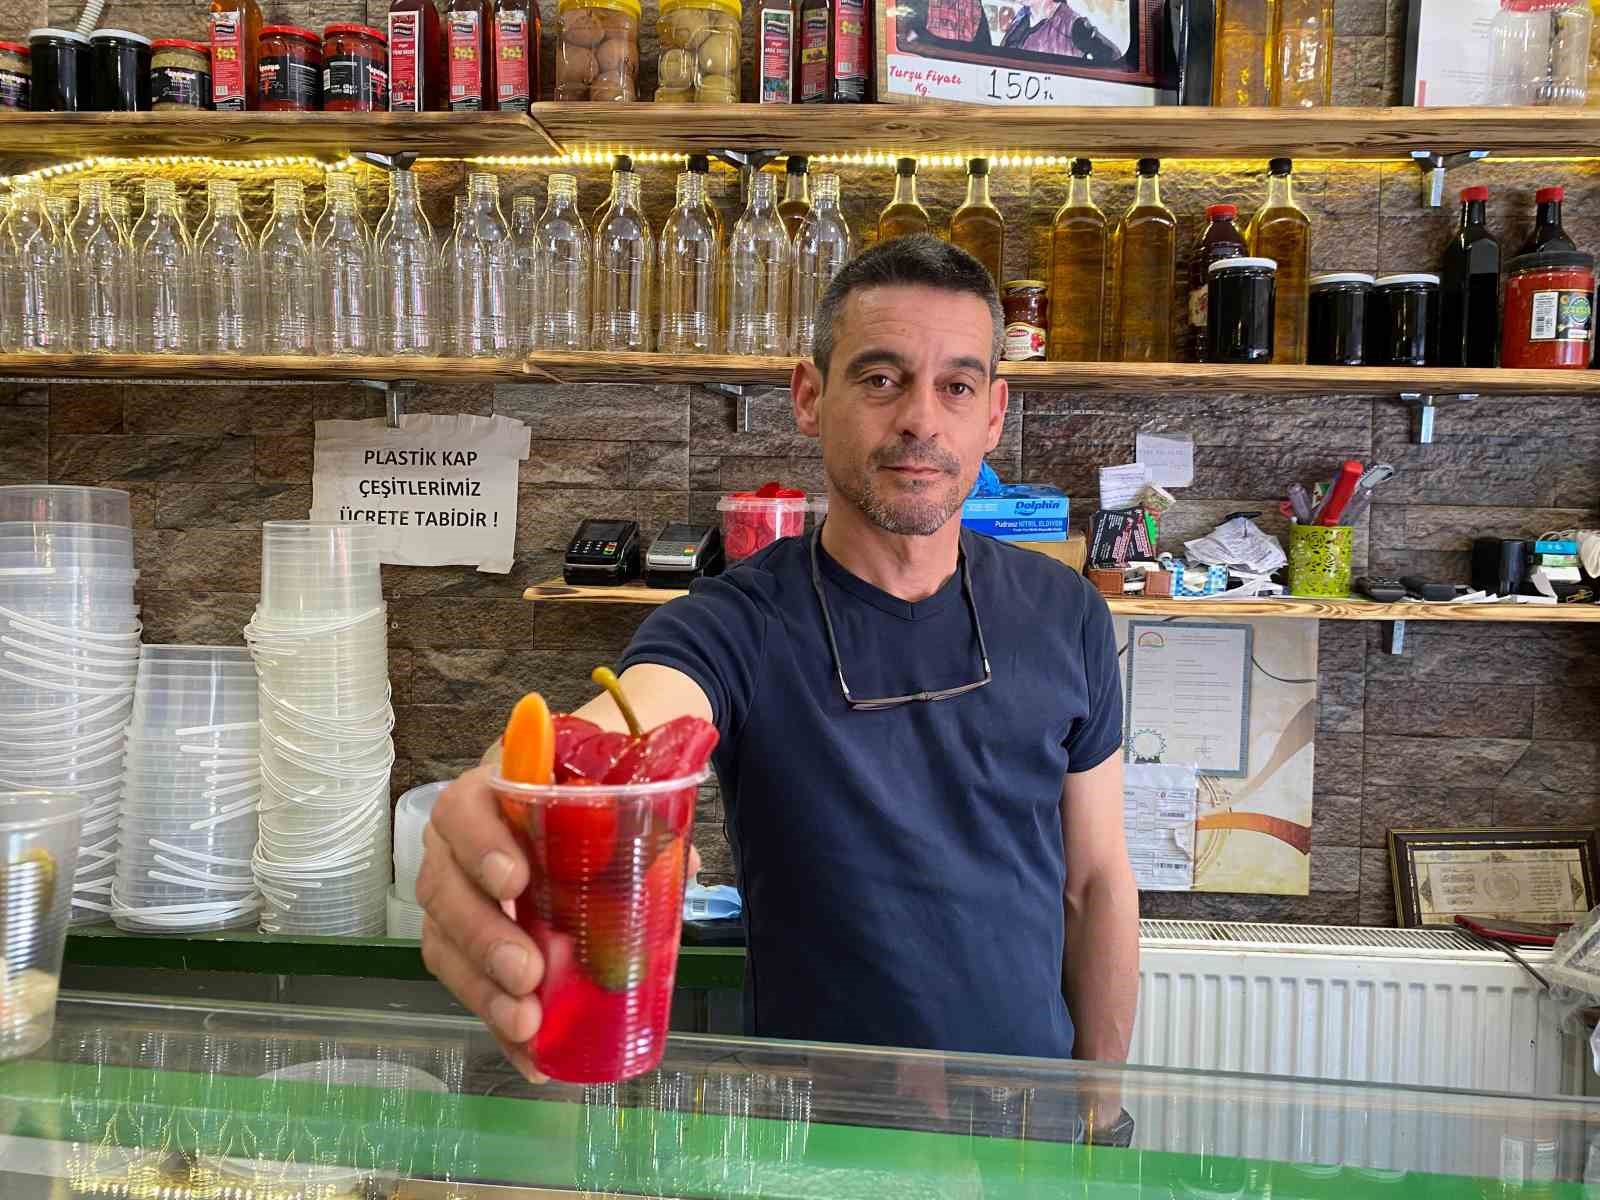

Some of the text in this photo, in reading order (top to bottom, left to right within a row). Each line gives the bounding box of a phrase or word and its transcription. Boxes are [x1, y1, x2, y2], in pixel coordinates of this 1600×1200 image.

[888, 66, 961, 86] Turşu Fiyatı
[987, 69, 1040, 101] 150
[364, 448, 478, 466] PLASTİK KAP
[359, 477, 481, 499] ÇEŞİTLERİMİZ
[1015, 500, 1060, 511] Dolphin
[414, 508, 486, 527] TABİDİR
